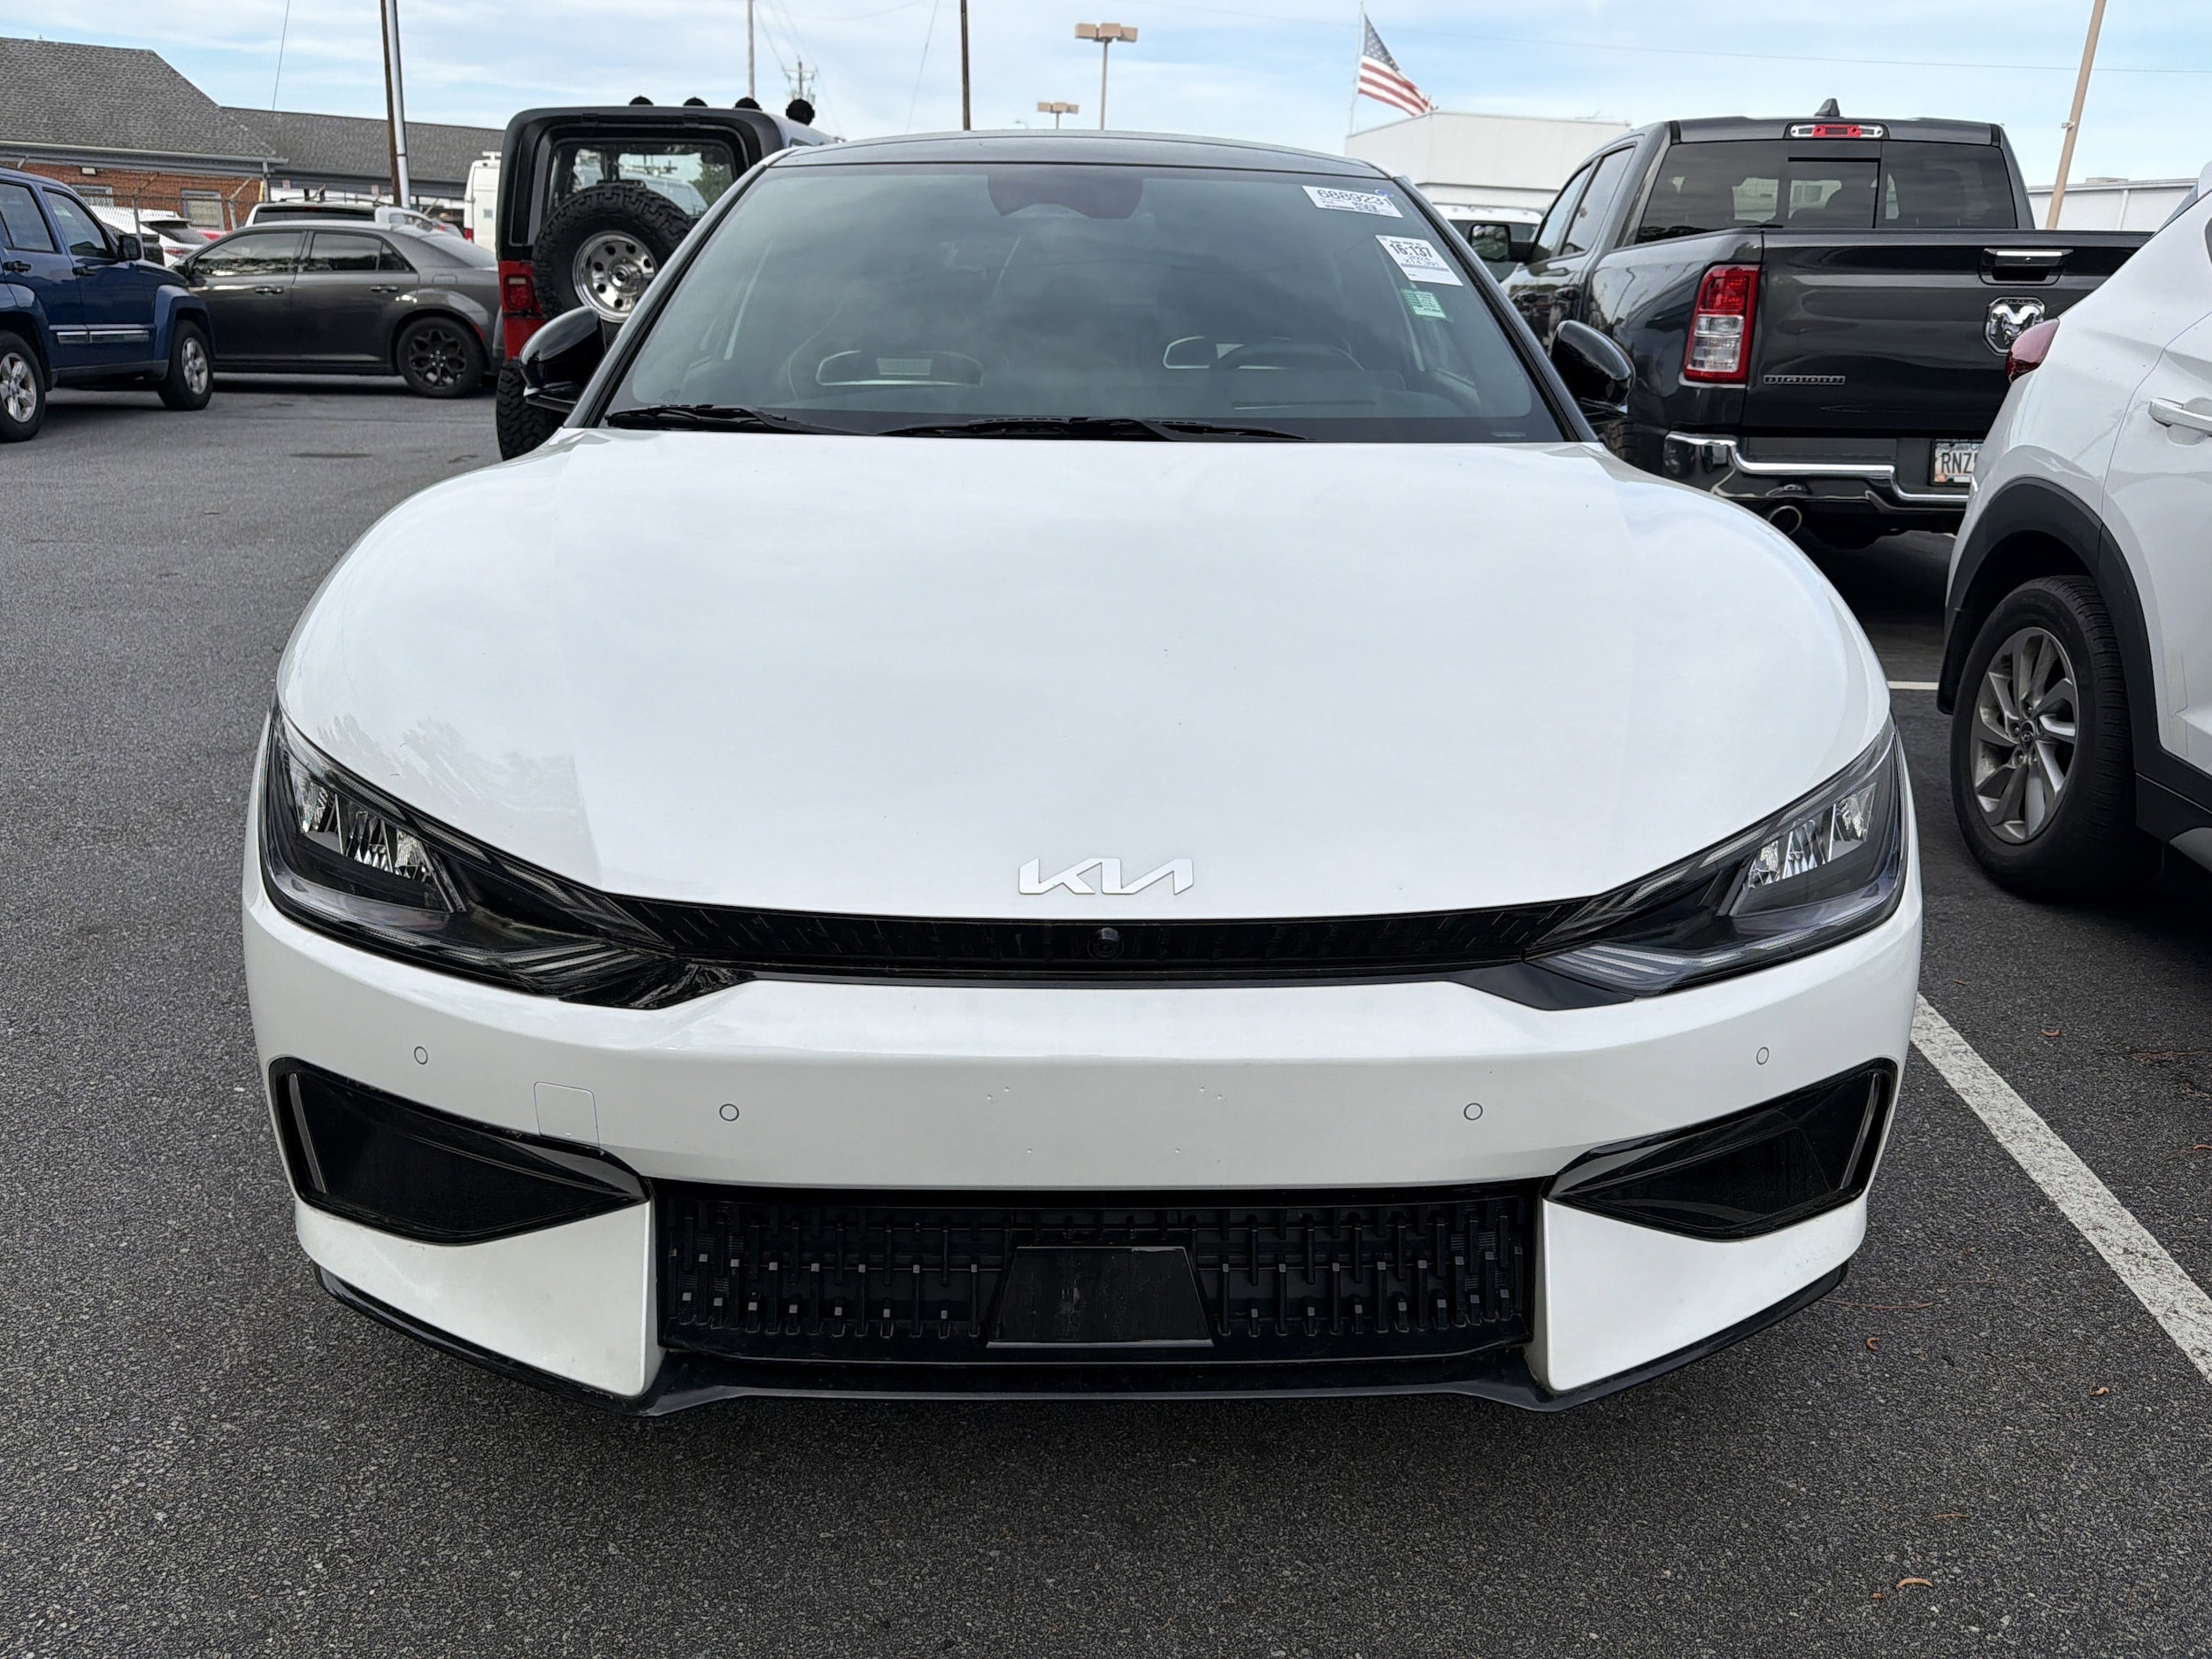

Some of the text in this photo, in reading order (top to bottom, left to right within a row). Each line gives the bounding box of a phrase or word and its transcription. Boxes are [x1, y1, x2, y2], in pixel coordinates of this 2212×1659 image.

[1317, 188, 1393, 207] 6889231
[1389, 243, 1433, 258] 16:137
[1018, 857, 1194, 895] KIA
